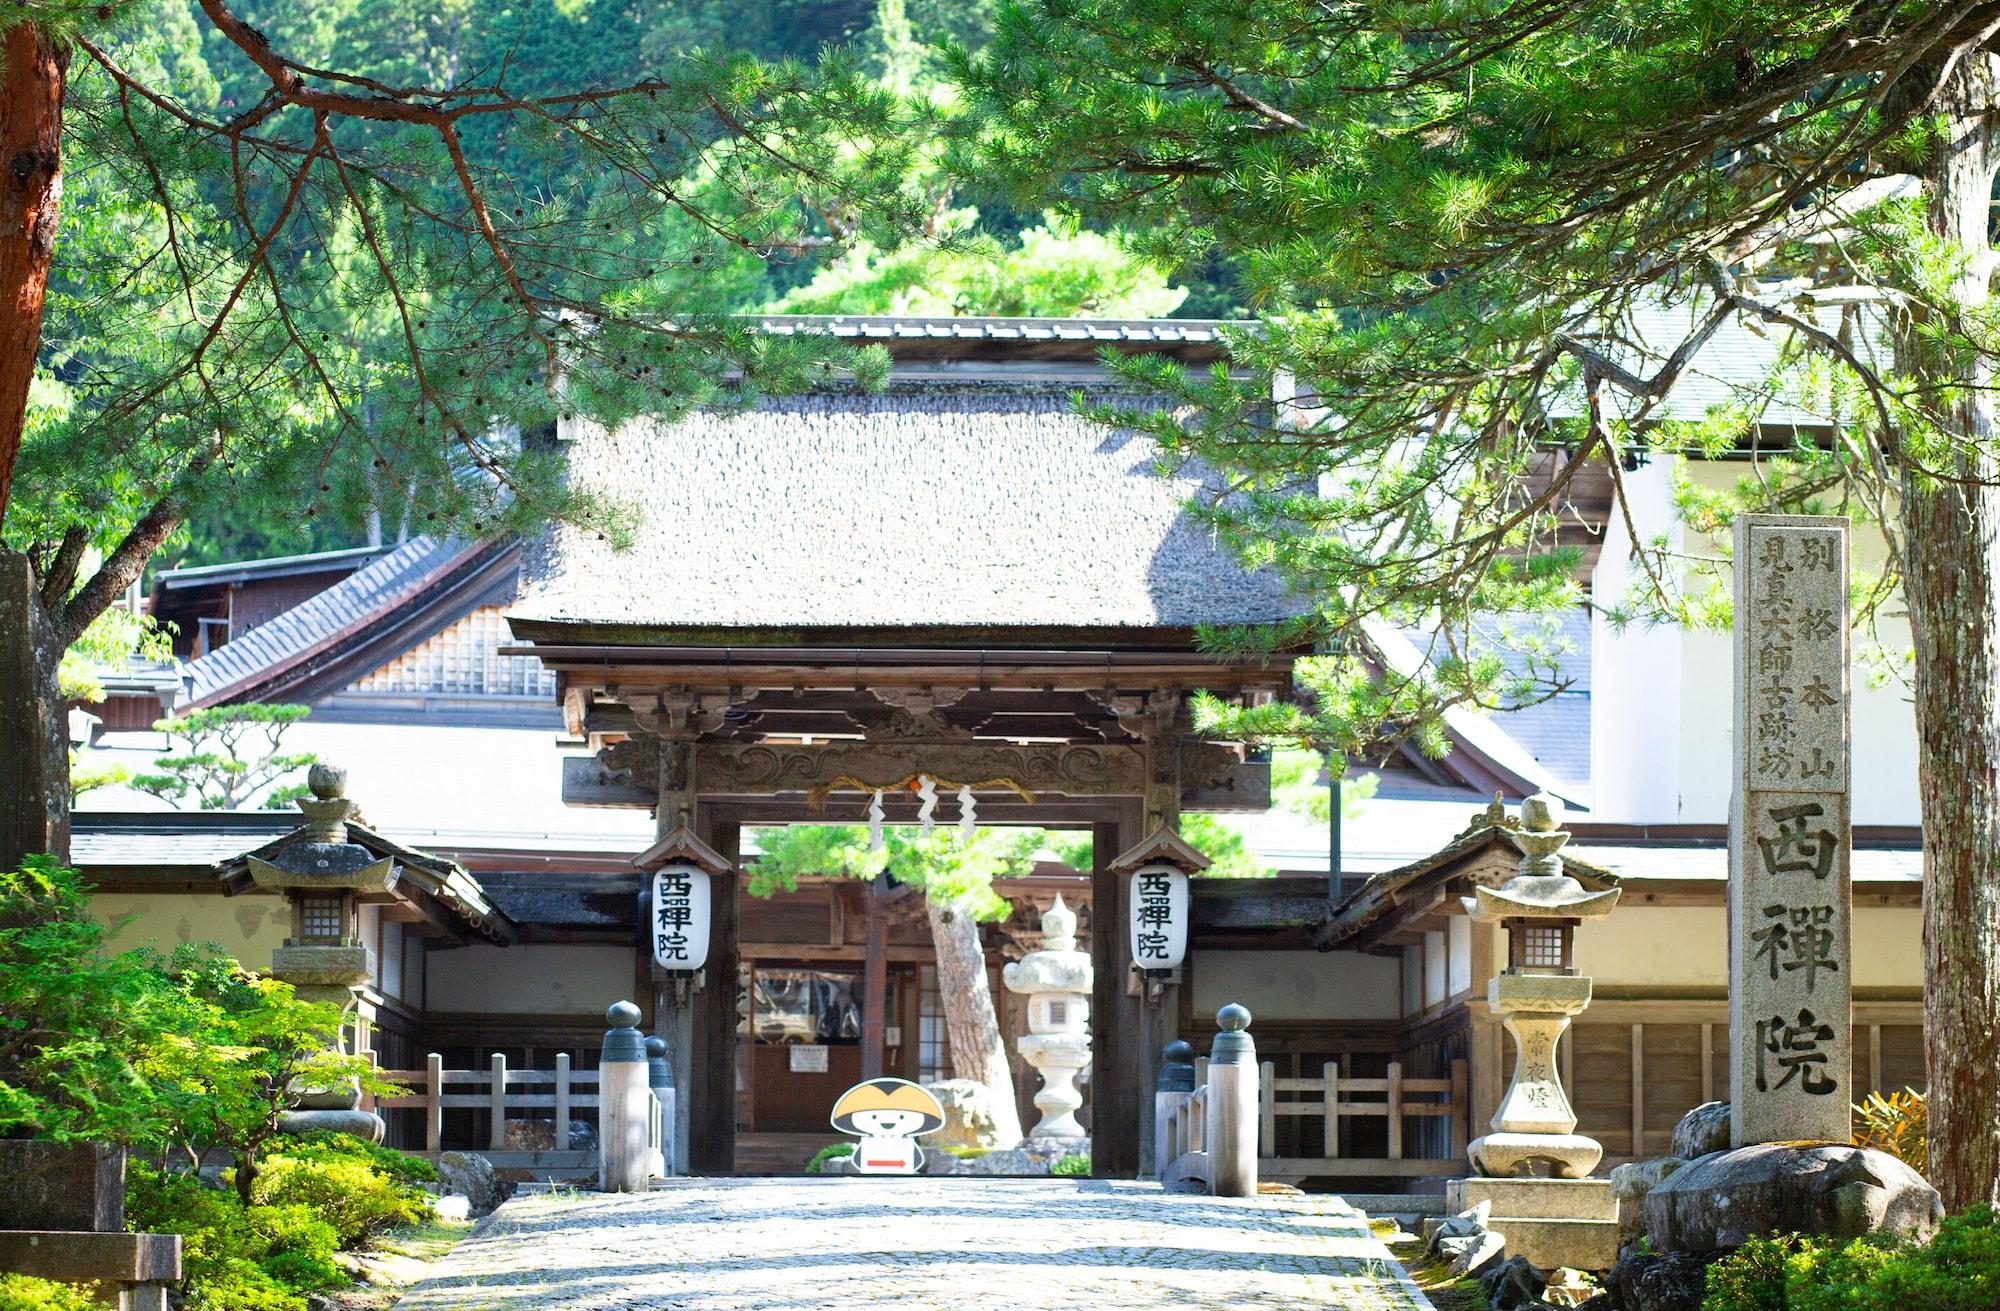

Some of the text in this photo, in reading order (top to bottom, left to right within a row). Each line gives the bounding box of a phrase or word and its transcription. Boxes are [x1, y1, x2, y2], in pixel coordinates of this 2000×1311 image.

[1797, 536, 1840, 780] 別格本山
[657, 872, 693, 960] 西禪院
[1137, 872, 1172, 959] 西禪院
[1752, 803, 1839, 1095] 西禪院
